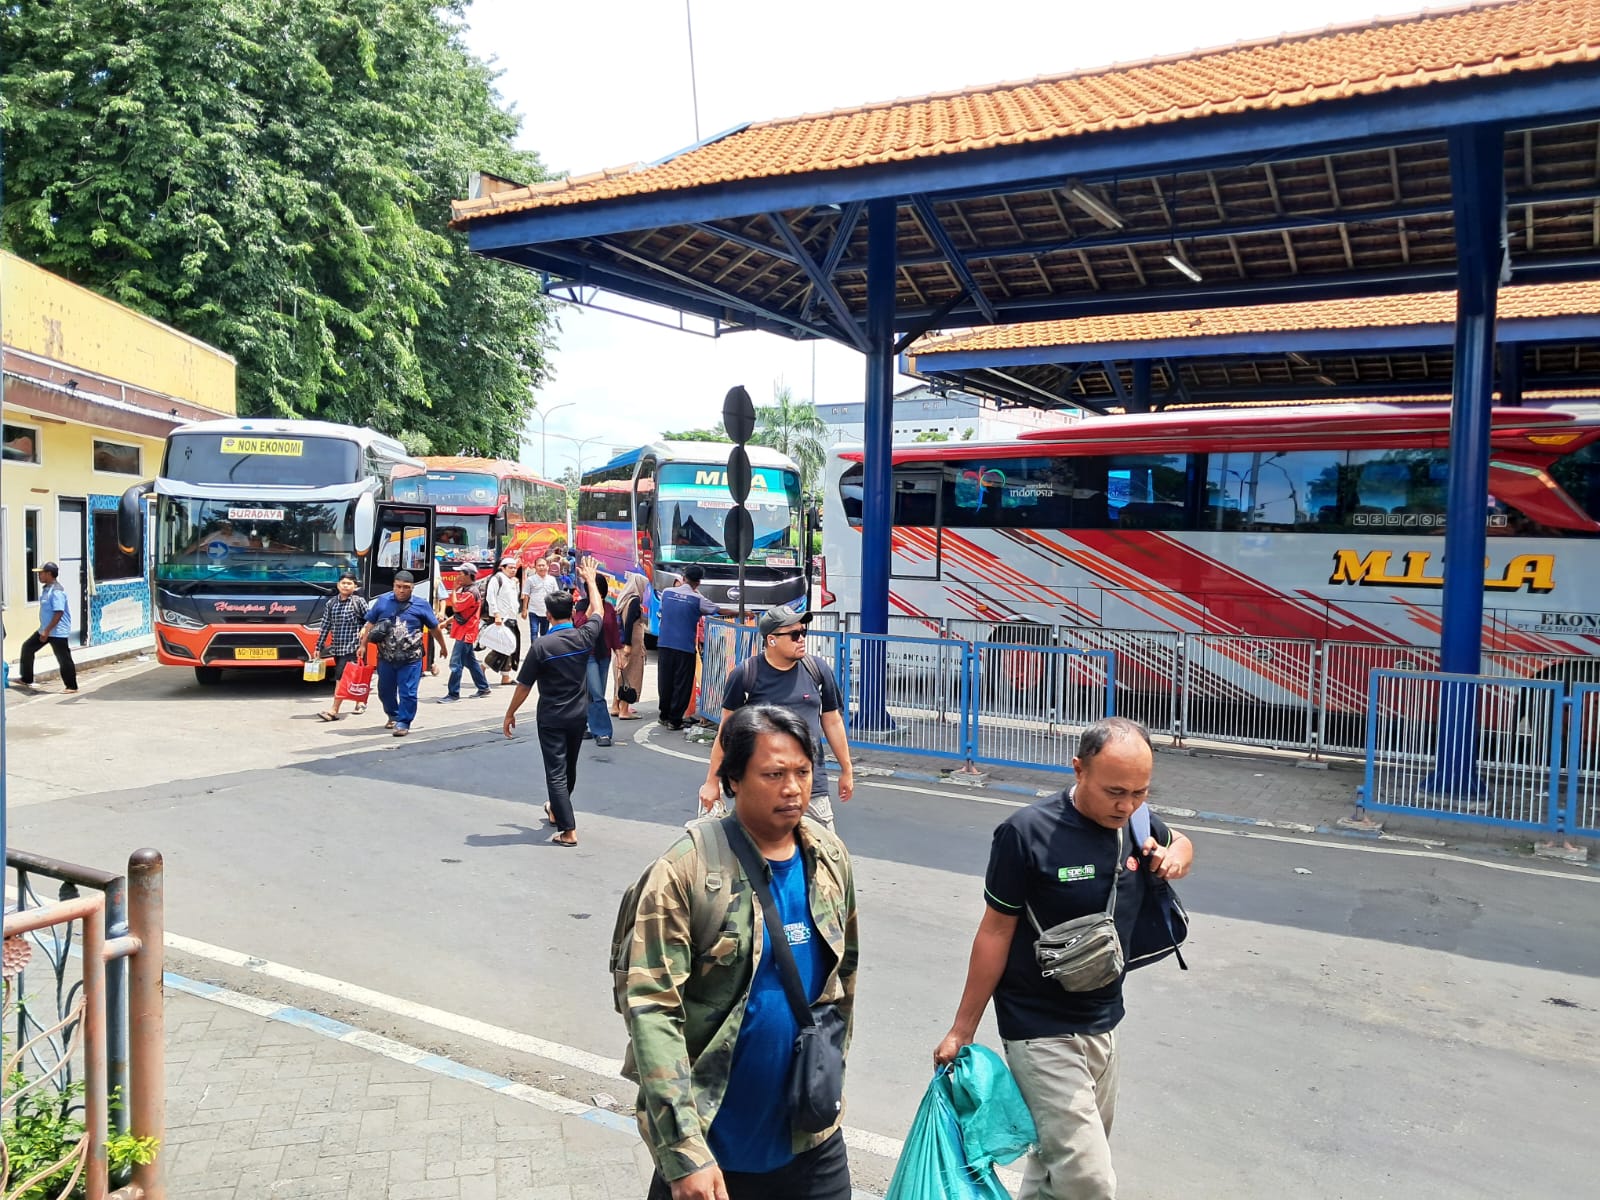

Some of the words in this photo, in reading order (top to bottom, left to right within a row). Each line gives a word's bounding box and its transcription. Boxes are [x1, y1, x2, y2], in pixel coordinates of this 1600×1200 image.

[238, 440, 257, 451] NON
[260, 441, 300, 453] EKONOMI
[695, 471, 767, 488] MIA
[1328, 549, 1556, 594] MIA
[1541, 613, 1600, 627] EKON
[1535, 624, 1553, 632] EKA
[1555, 626, 1579, 634] MIRA
[1582, 627, 1600, 635] PRI
